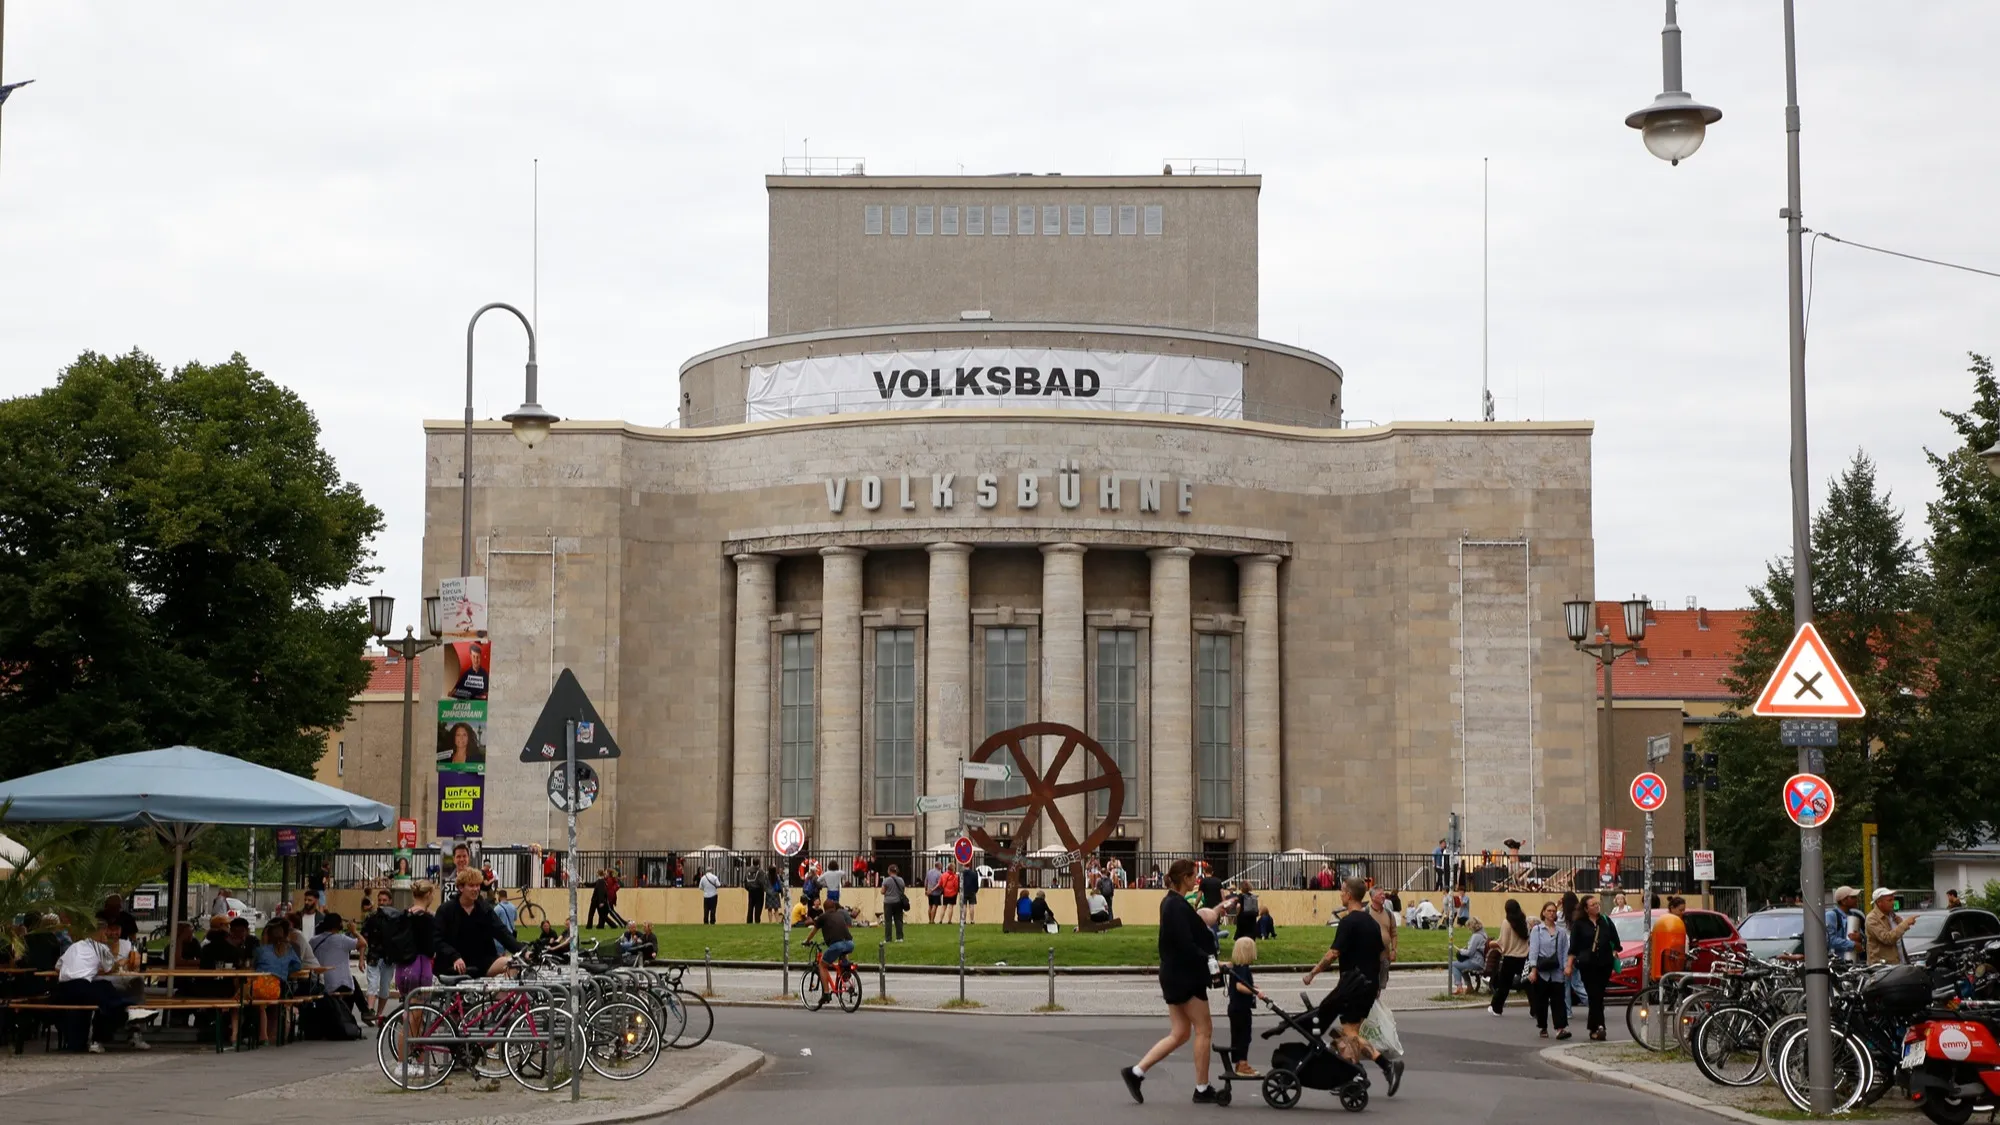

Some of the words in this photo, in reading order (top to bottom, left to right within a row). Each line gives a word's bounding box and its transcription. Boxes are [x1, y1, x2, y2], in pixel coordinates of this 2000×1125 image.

[873, 366, 1100, 399] VOLKSBAD
[825, 459, 1193, 513] VOLKSBÜHNE
[453, 702, 471, 710] KATJA
[441, 710, 483, 718] ZIMMERMANN
[444, 800, 471, 809] berlin
[462, 824, 480, 833] Volt
[780, 830, 797, 845] 30
[1942, 1041, 1968, 1050] emmy
